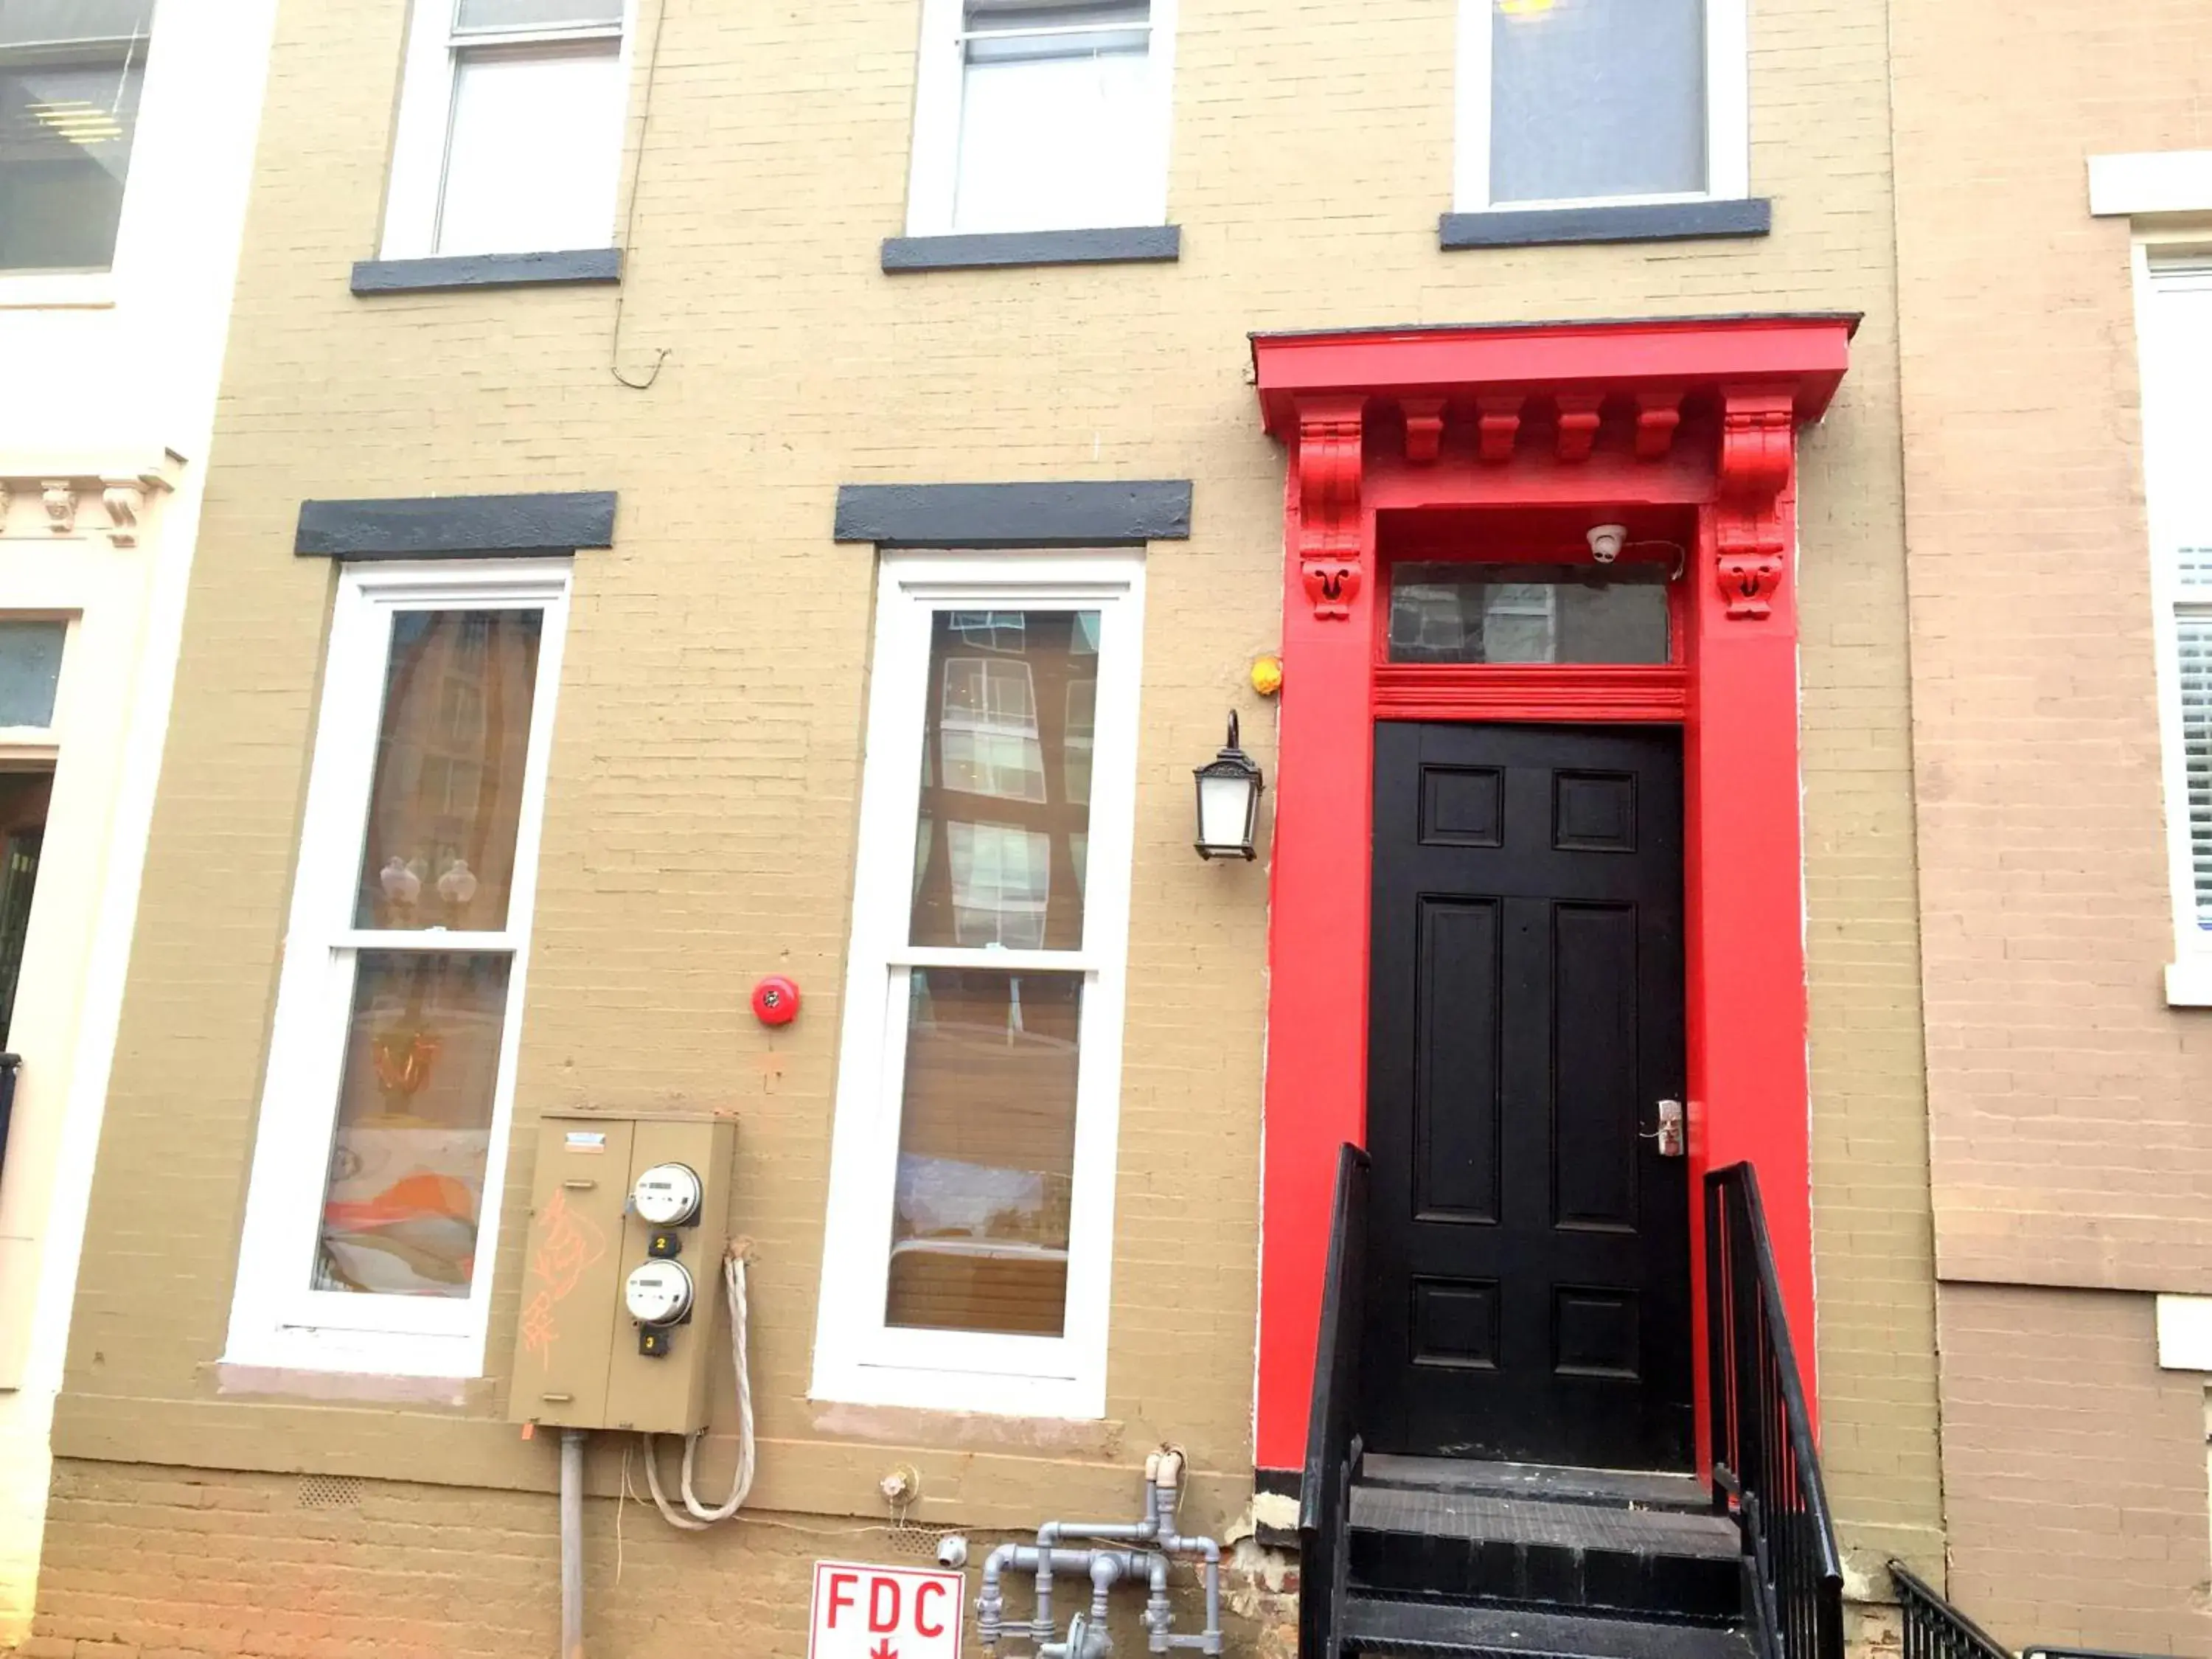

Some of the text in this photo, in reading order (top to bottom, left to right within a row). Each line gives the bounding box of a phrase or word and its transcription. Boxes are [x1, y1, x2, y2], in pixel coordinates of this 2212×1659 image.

[656, 1238, 666, 1248] 2
[646, 1337, 654, 1349] 3
[827, 1574, 946, 1638] FDC
